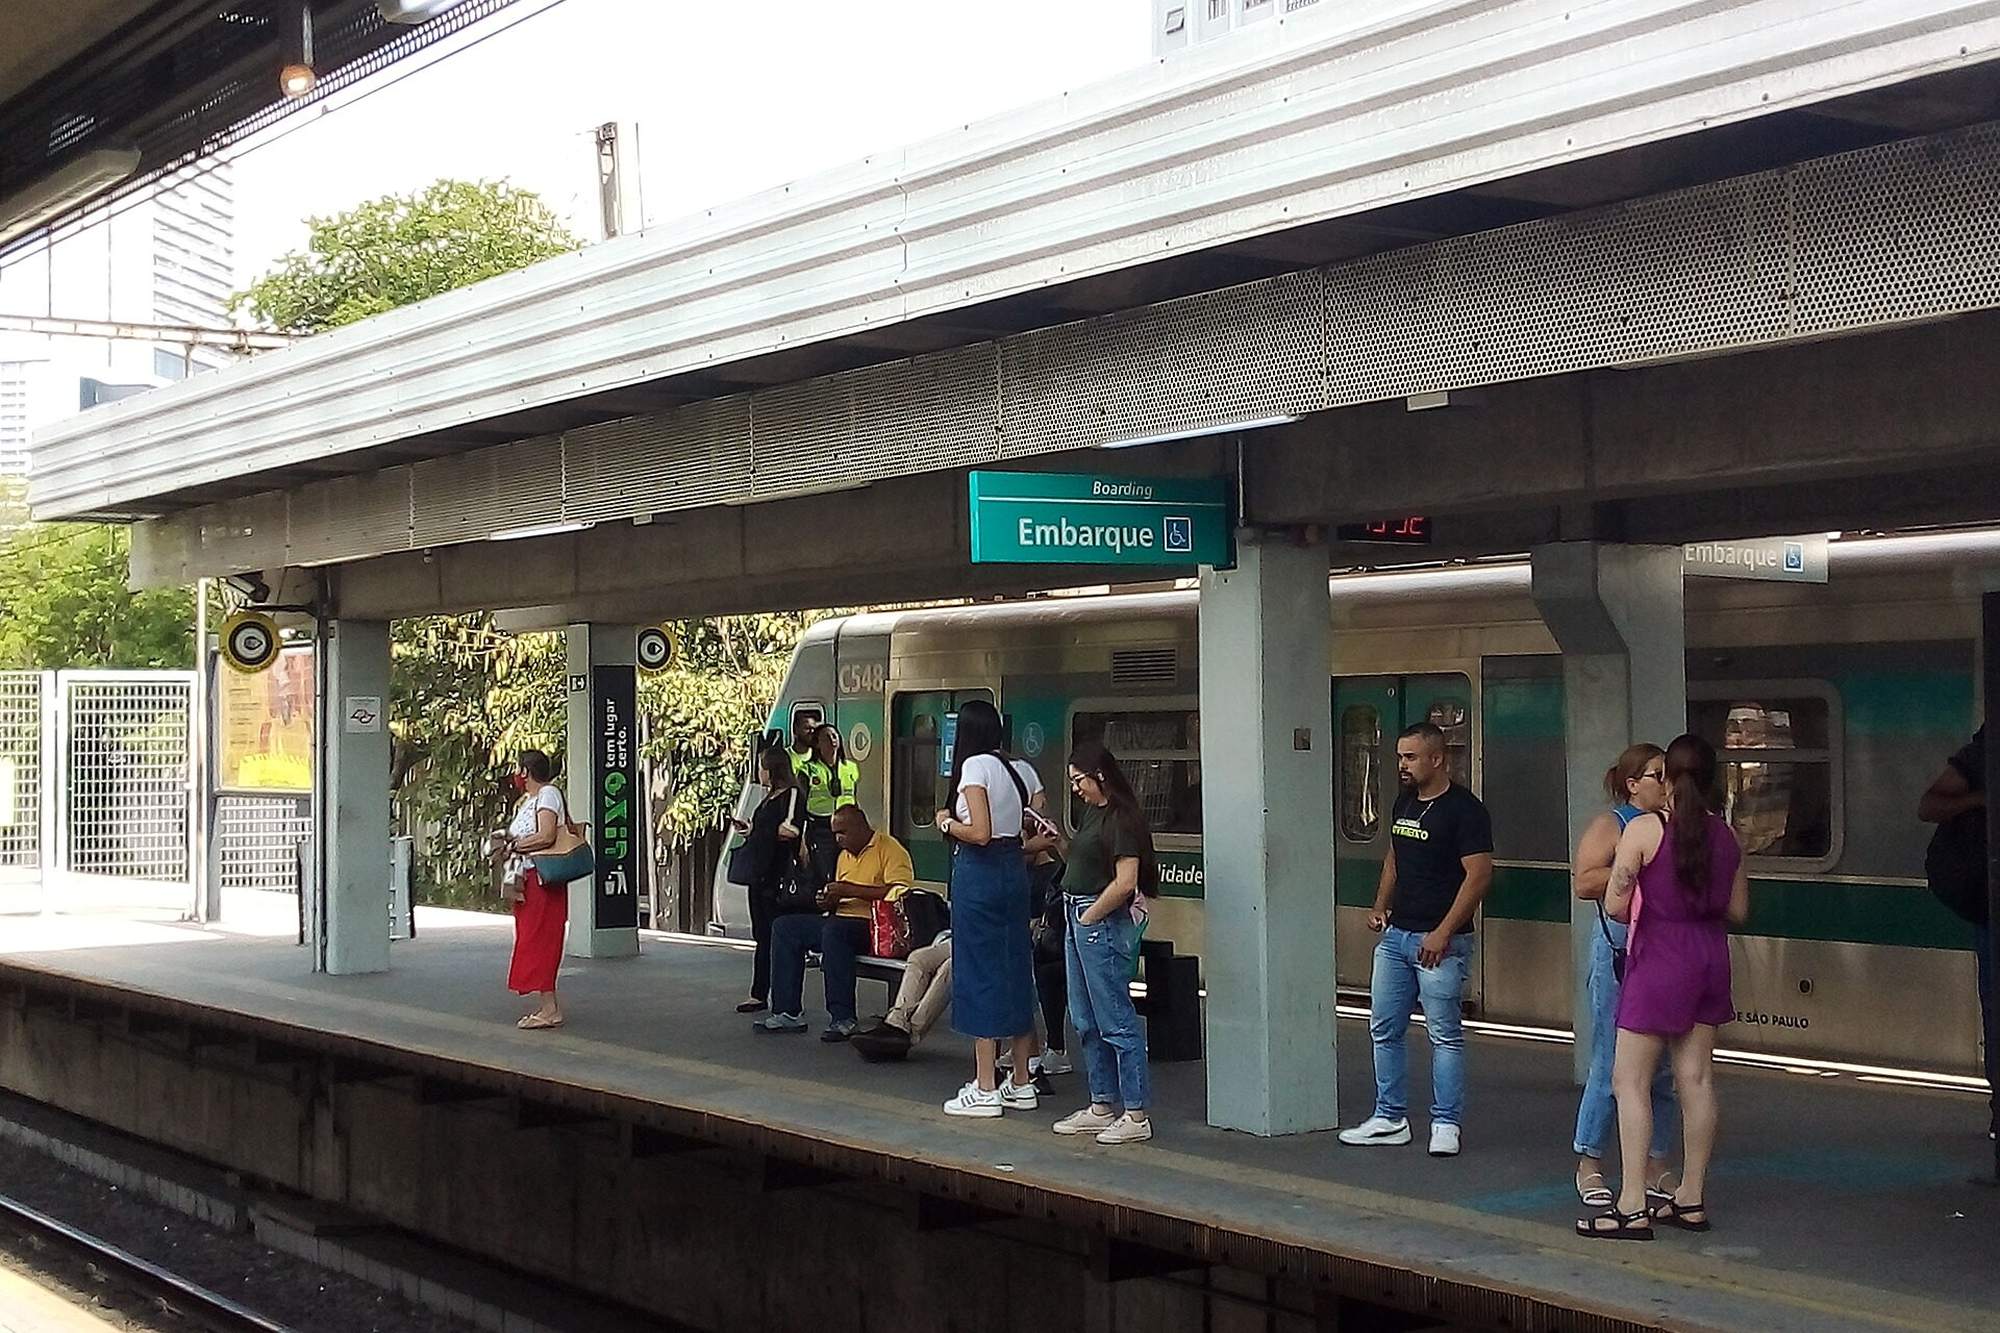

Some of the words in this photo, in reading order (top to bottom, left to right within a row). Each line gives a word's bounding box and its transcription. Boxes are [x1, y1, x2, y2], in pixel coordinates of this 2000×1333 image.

[1092, 481, 1153, 499] Boarding
[1018, 517, 1154, 553] Embarque
[1684, 543, 1777, 571] Embarque
[839, 663, 883, 693] C548
[604, 698, 618, 736] lugar
[617, 726, 627, 768] certo.
[1772, 1014, 1809, 1029] PAULO
